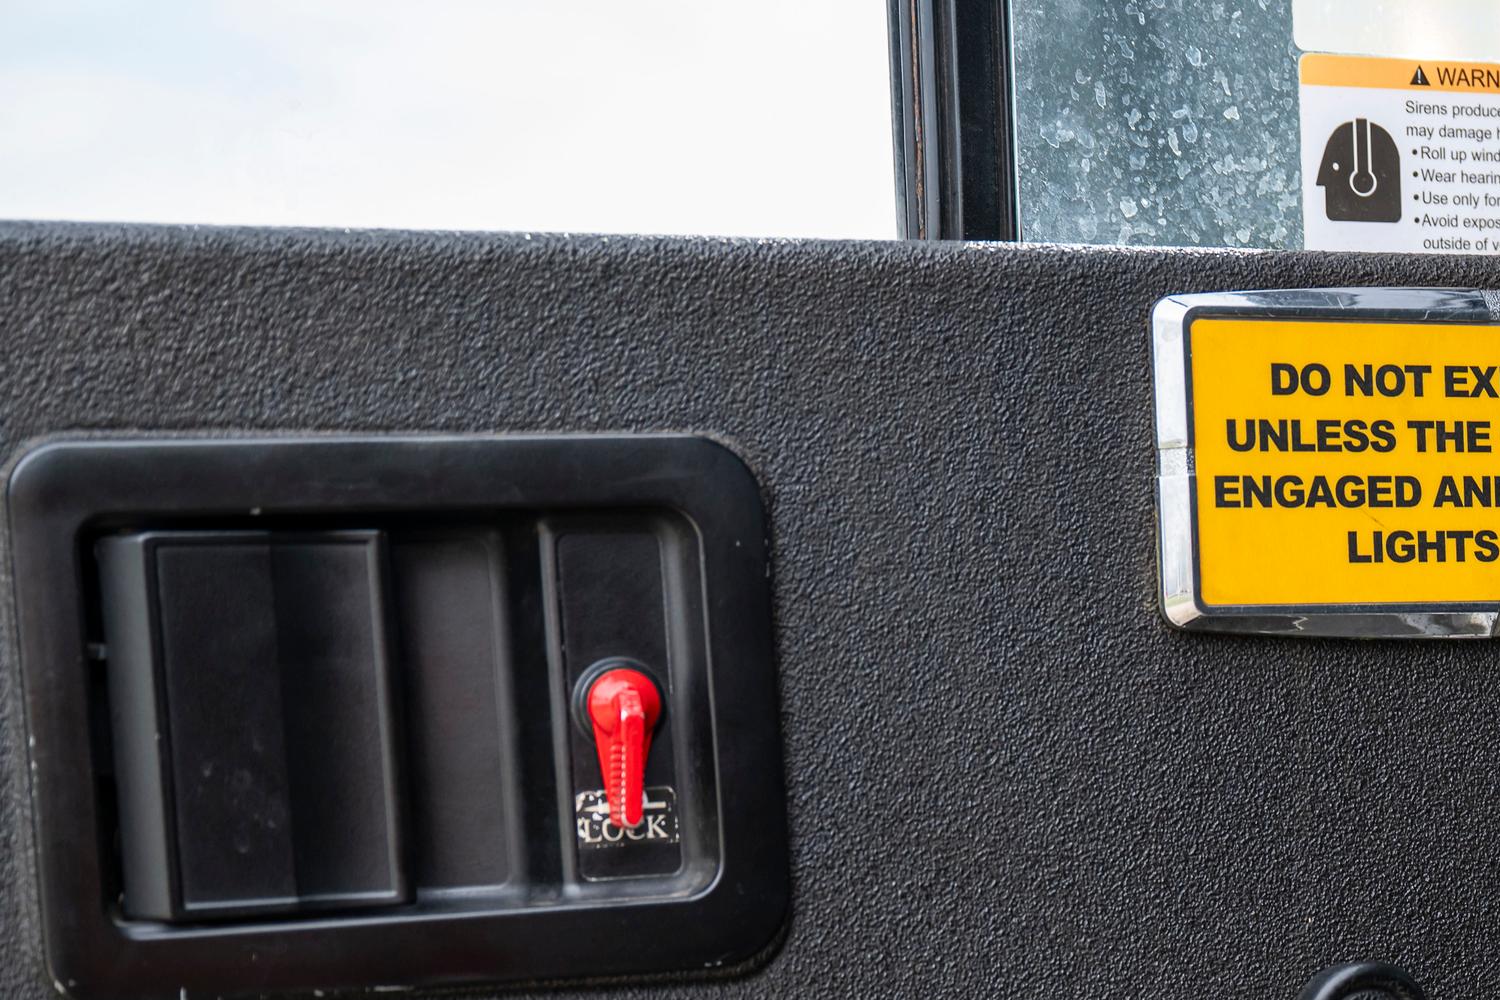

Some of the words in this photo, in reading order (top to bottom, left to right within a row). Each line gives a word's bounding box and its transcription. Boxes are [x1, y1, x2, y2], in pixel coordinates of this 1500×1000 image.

[1406, 101, 1448, 115] Sirens
[1406, 126, 1434, 140] may
[1439, 126, 1492, 142] damage
[1421, 147, 1446, 160] Roll
[1451, 150, 1467, 165] up
[1422, 169, 1457, 184] Wear
[1422, 192, 1448, 206] Use
[1453, 193, 1480, 211] only
[1485, 194, 1500, 207] for
[1422, 215, 1458, 229] Avoid
[1424, 238, 1471, 251] outside
[1476, 238, 1488, 251] of
[1270, 363, 1331, 397] DO
[1344, 365, 1431, 398] NOT
[1225, 418, 1396, 453] UNLESS
[1408, 420, 1492, 453] THE
[1214, 475, 1422, 509] ENGAGED
[1347, 530, 1499, 564] LIGHTS
[584, 815, 668, 843] LOCK
